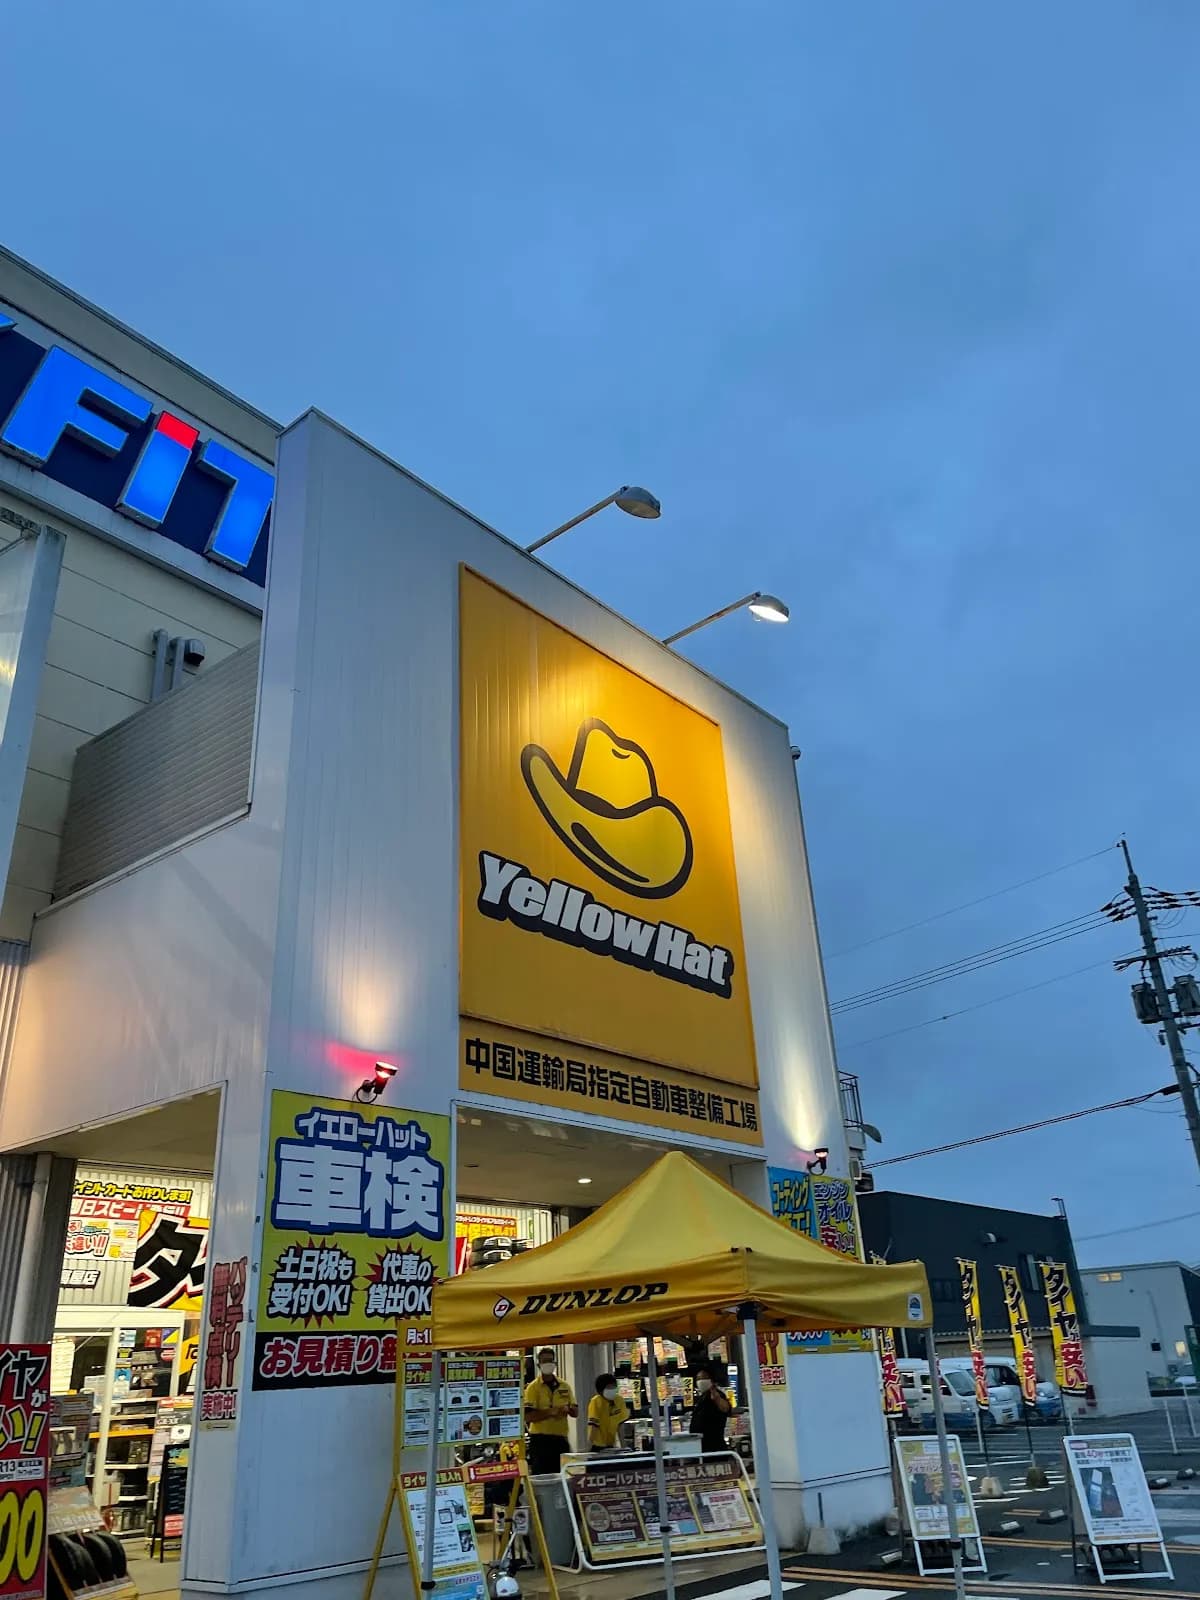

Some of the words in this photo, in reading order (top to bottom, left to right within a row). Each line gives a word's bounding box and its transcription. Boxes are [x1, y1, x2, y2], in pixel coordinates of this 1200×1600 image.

[478, 851, 734, 999] YellowHat
[465, 1037, 758, 1132] 中国運輸局指定自動車整備工場
[297, 1110, 429, 1151] イエローハット
[274, 1142, 440, 1234] 車検
[814, 1180, 848, 1200] エンジン
[275, 1247, 354, 1281] 土日祝も
[382, 1252, 432, 1283] 代車の
[268, 1282, 351, 1316] 受付OK!
[517, 1282, 669, 1316] DUNLOP
